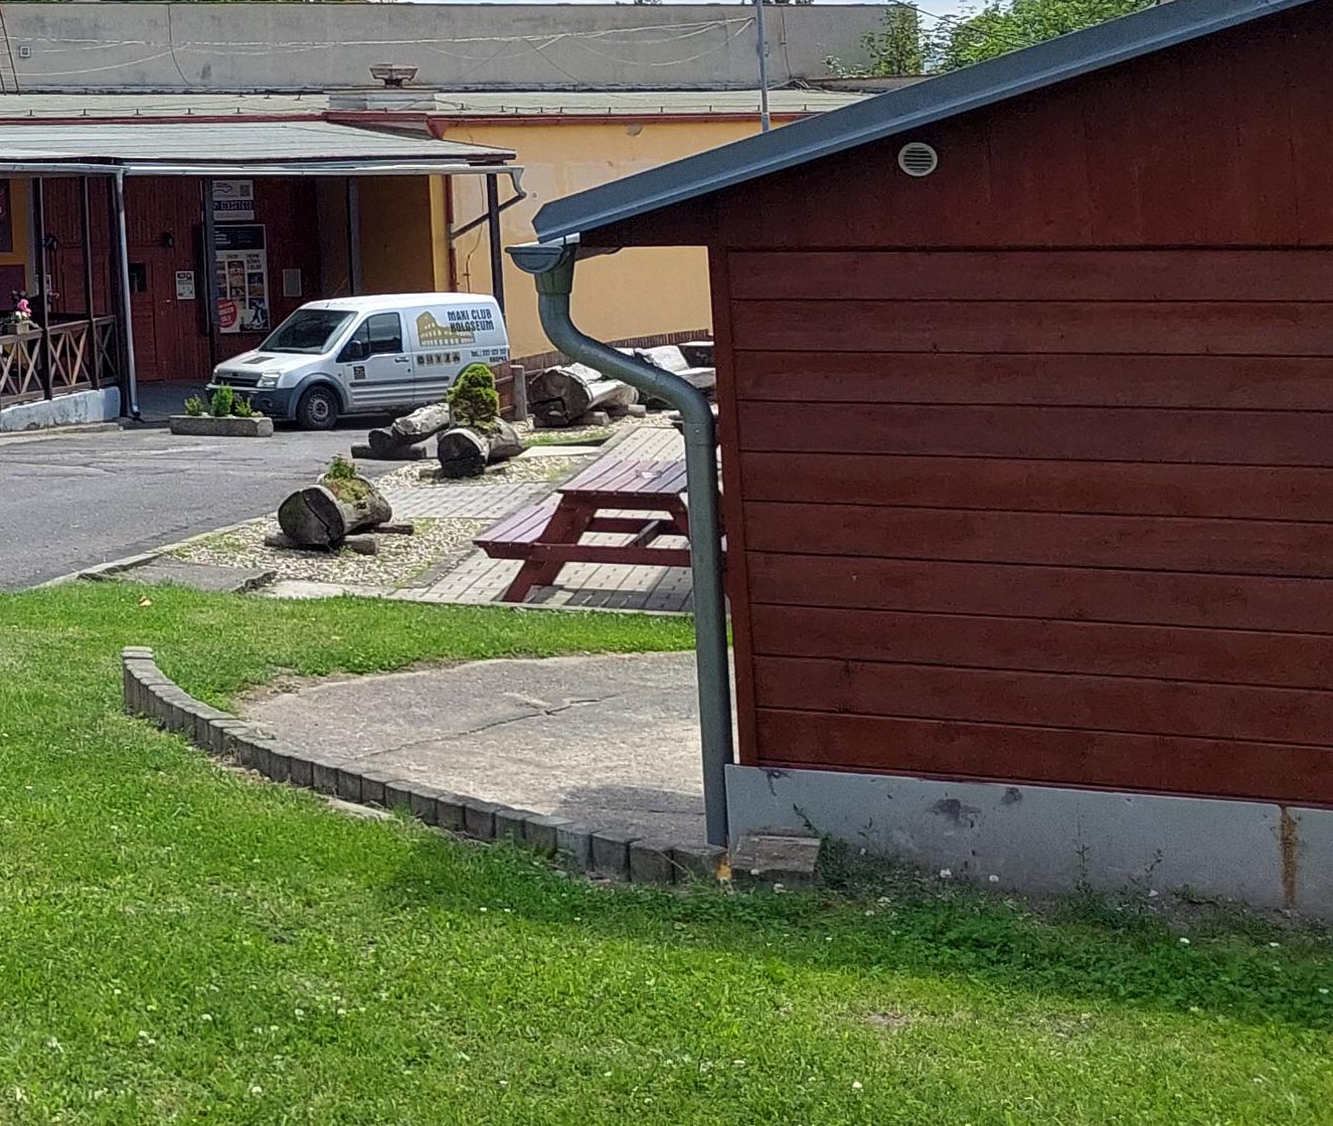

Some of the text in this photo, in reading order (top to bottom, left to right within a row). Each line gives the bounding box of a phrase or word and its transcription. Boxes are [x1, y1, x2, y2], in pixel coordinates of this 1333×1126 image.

[447, 309, 492, 321] MAXI CLUB
[450, 320, 494, 333] KOLOSEUM
